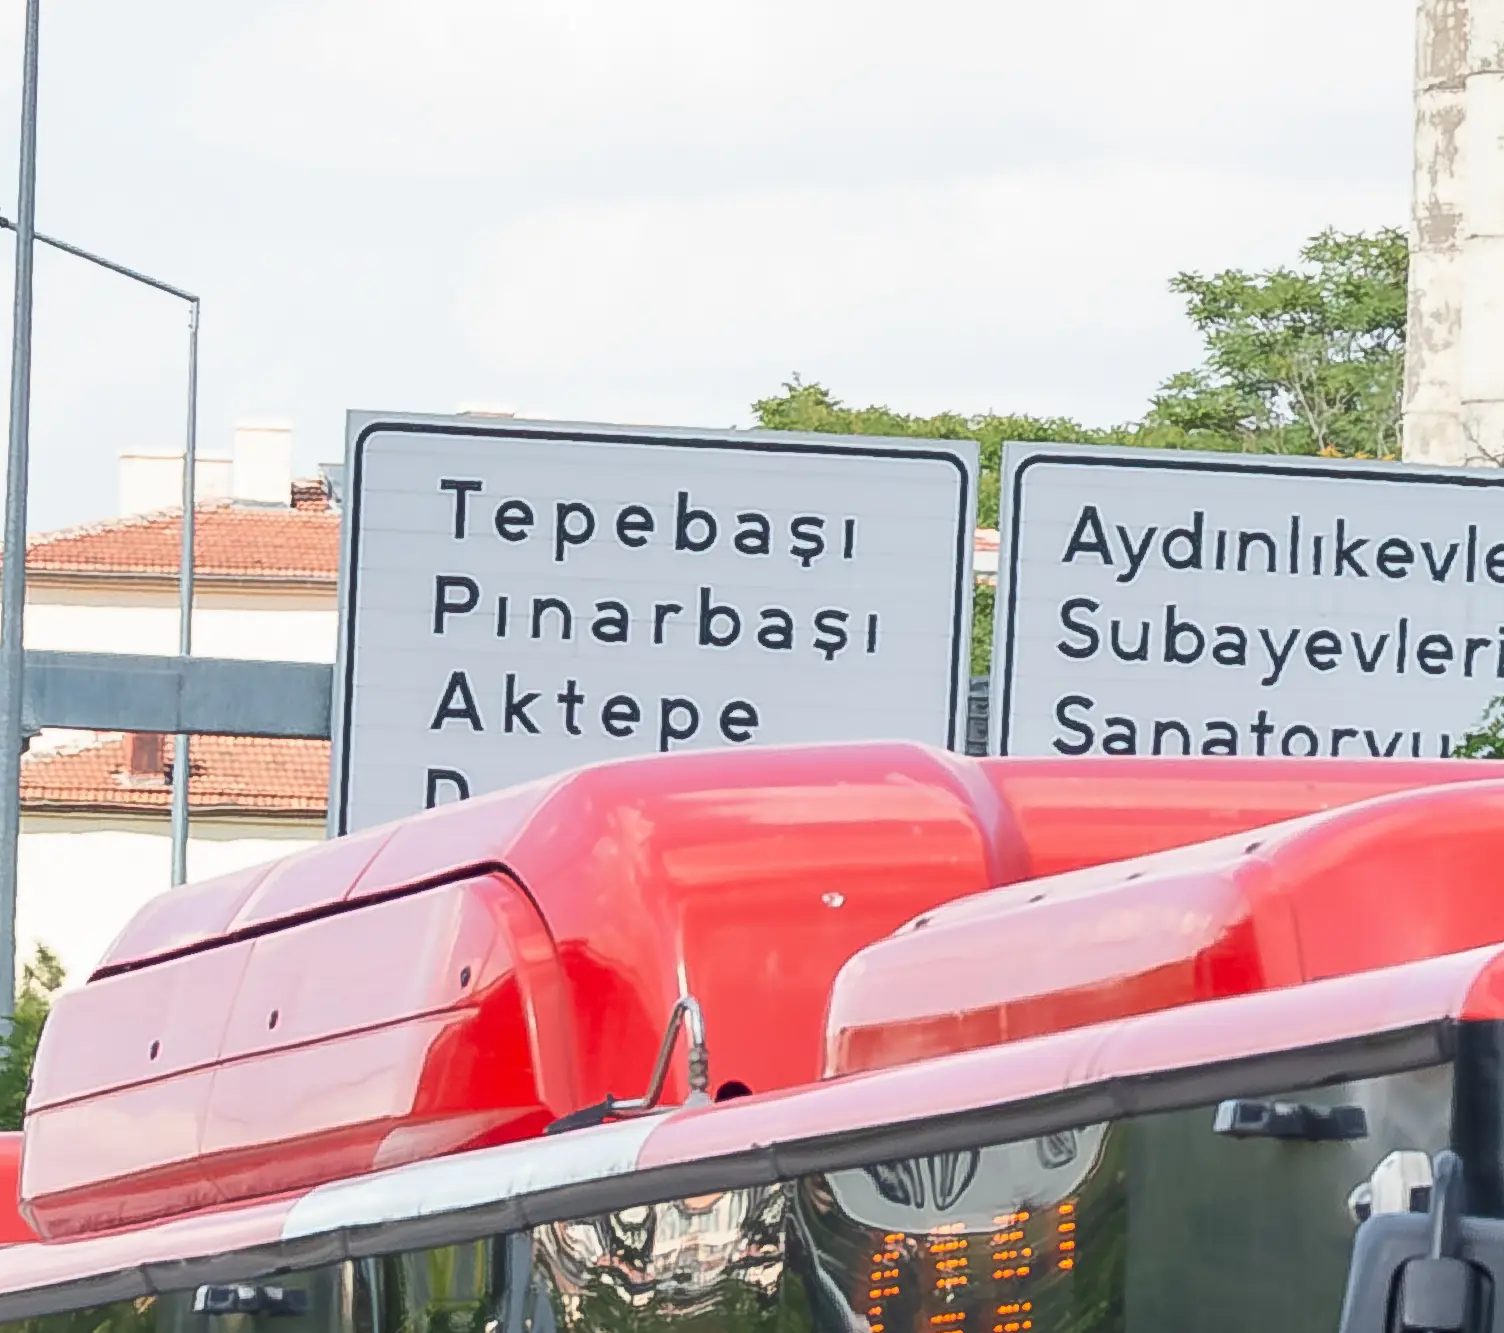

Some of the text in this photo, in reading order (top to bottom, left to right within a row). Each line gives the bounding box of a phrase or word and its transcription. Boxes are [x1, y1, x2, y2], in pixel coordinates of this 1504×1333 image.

[439, 478, 857, 569] Tepebaşı
[432, 574, 879, 661] Pınarbaşı
[430, 670, 760, 751] Aktepe
